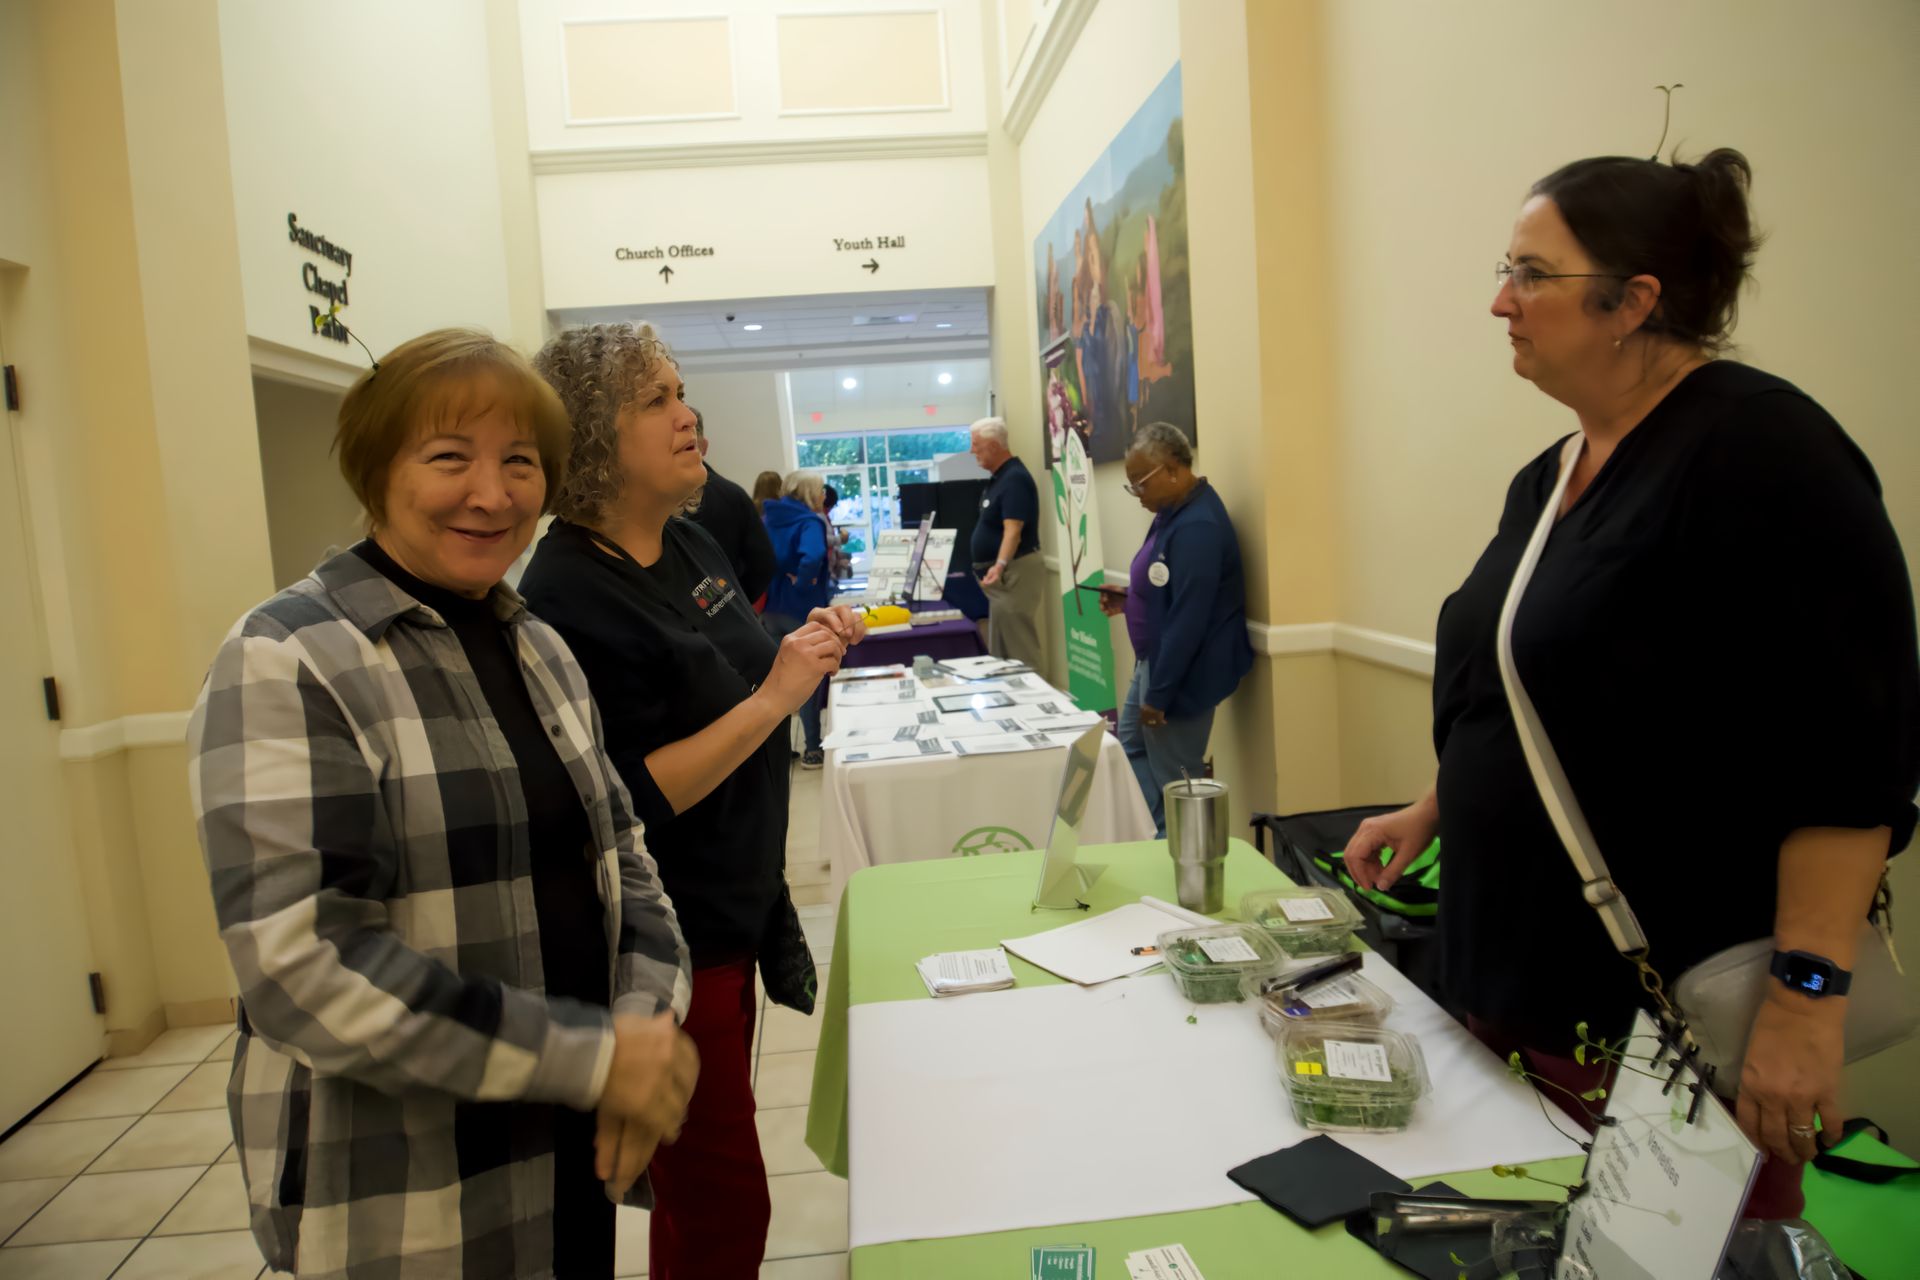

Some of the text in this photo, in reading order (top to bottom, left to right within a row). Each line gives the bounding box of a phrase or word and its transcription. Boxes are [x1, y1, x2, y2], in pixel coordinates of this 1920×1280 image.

[287, 211, 353, 278] Sanctuary
[615, 244, 715, 261] Church Offices
[833, 235, 906, 251] Youth Hall
[302, 261, 349, 309] Chapel
[1647, 1129, 1680, 1188] Varieties
